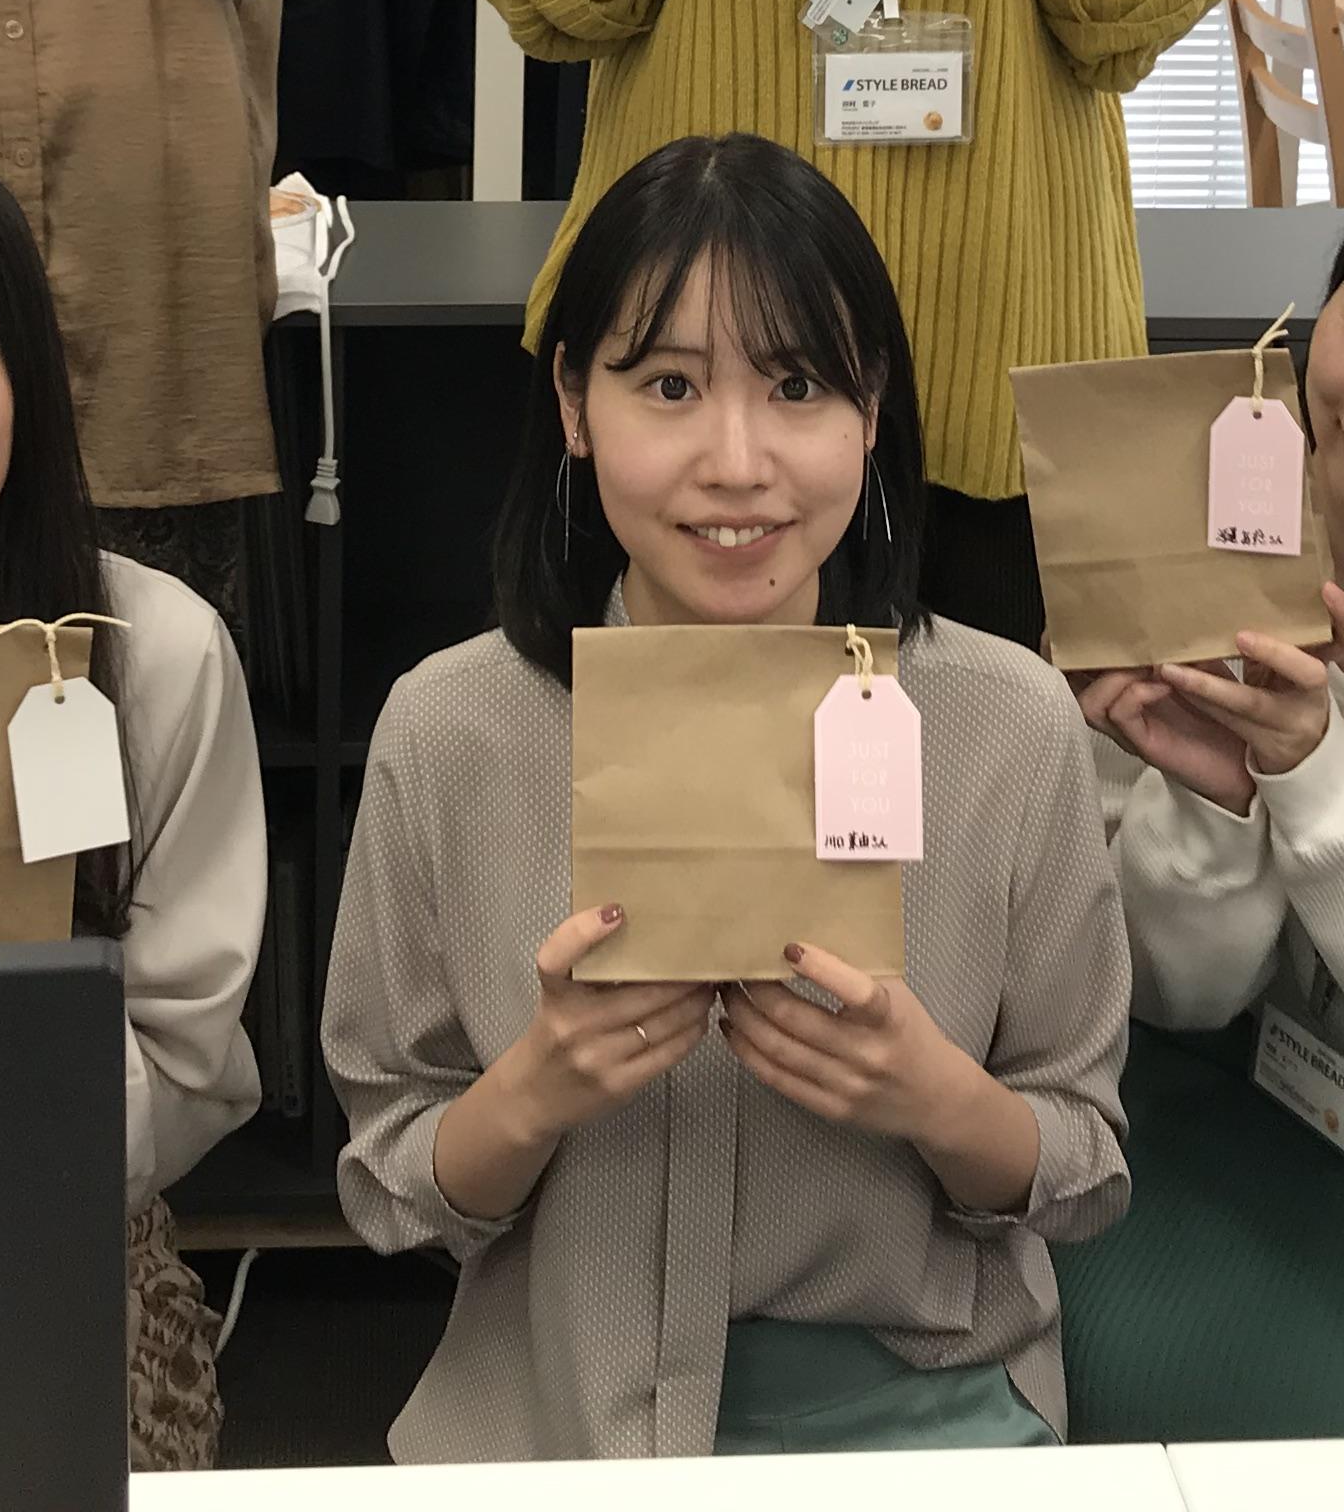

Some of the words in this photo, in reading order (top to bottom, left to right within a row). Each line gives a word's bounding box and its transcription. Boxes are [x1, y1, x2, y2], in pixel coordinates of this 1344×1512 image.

[856, 78, 898, 92] STYLE
[901, 78, 948, 91] BREAD
[848, 740, 889, 760] JUST
[849, 796, 891, 815] YOU
